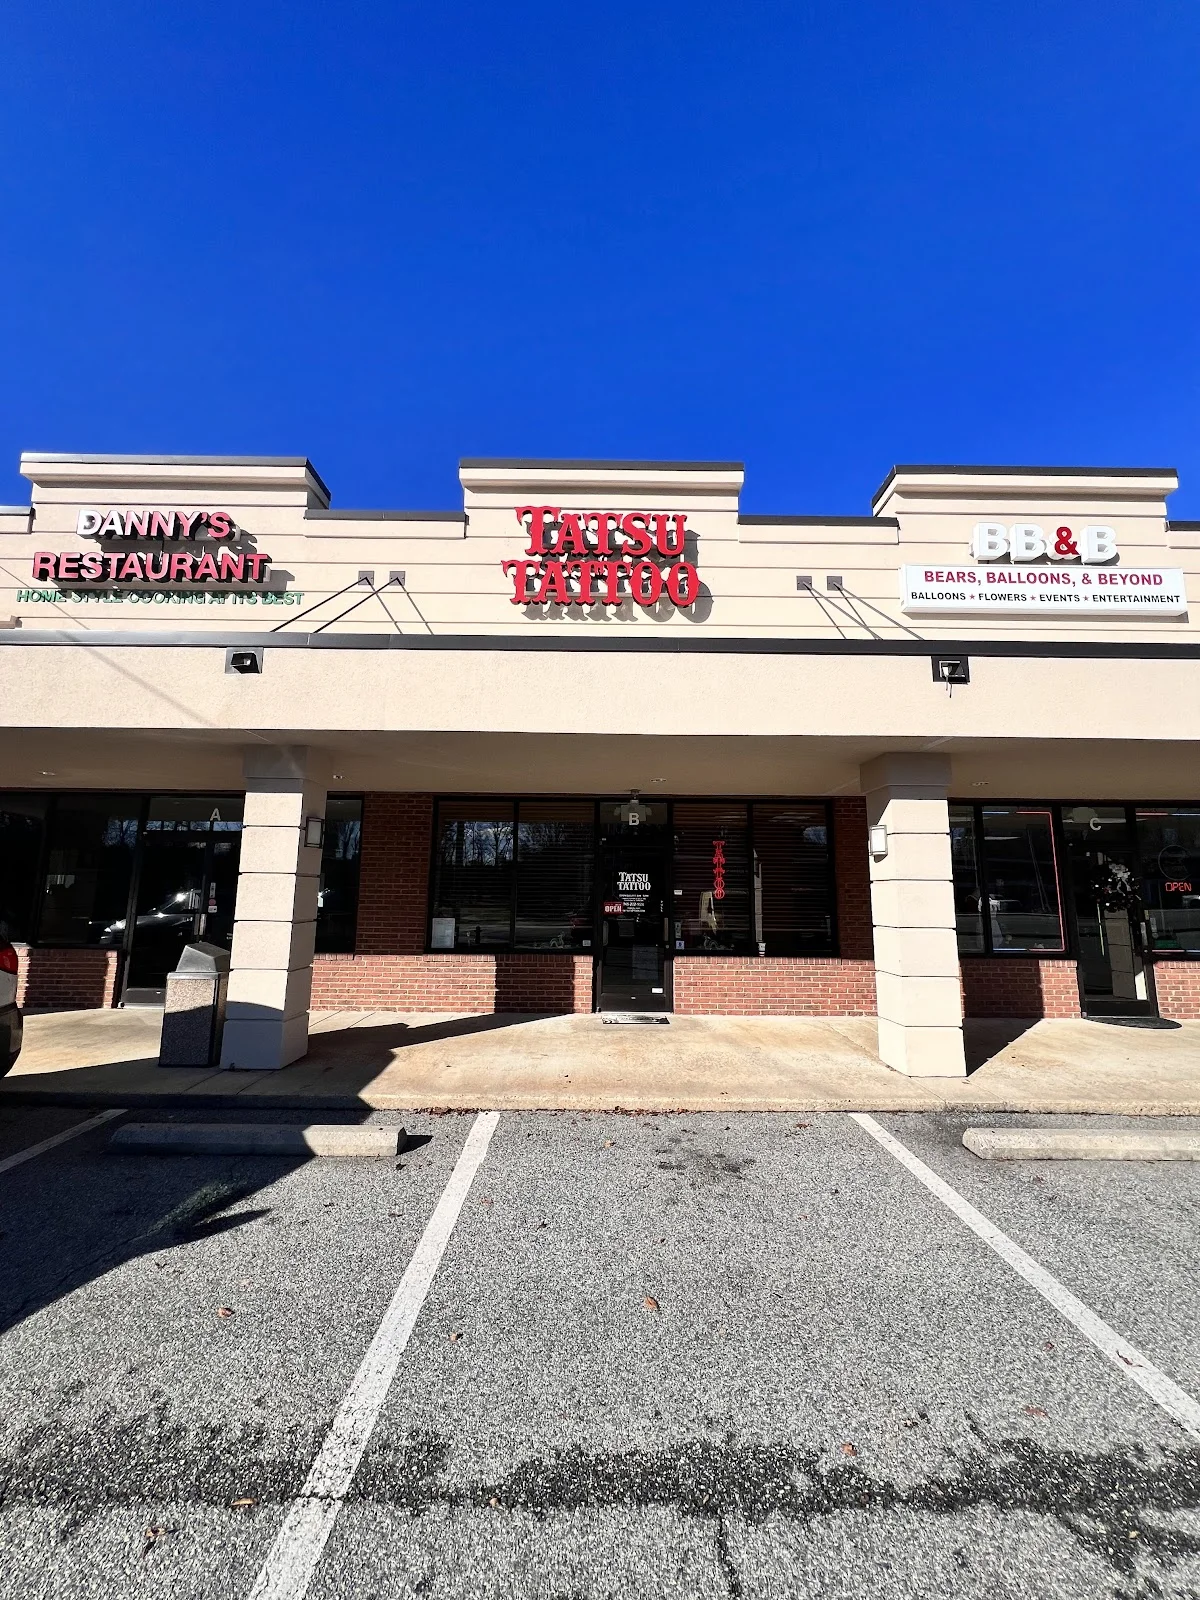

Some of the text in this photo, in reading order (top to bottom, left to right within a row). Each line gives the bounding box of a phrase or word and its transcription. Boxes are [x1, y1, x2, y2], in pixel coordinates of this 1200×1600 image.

[76, 509, 232, 539] DANNY'S
[973, 522, 1118, 563] BB&B
[32, 551, 270, 582] RESTAURANT
[501, 559, 699, 608] TATTOO
[924, 570, 1163, 587] BEARS, BALLOONS, & BEYOND
[16, 589, 67, 603] HOME
[261, 591, 305, 606] BEST
[911, 592, 1180, 603] BALLOONS FLOWERS EVENTS ENTERTAINMENT
[209, 808, 221, 821] A
[628, 813, 640, 826] B
[1089, 818, 1101, 831] C
[713, 840, 725, 899] TATTOO
[616, 881, 651, 891] TATTOO
[1165, 882, 1192, 892] OPEN
